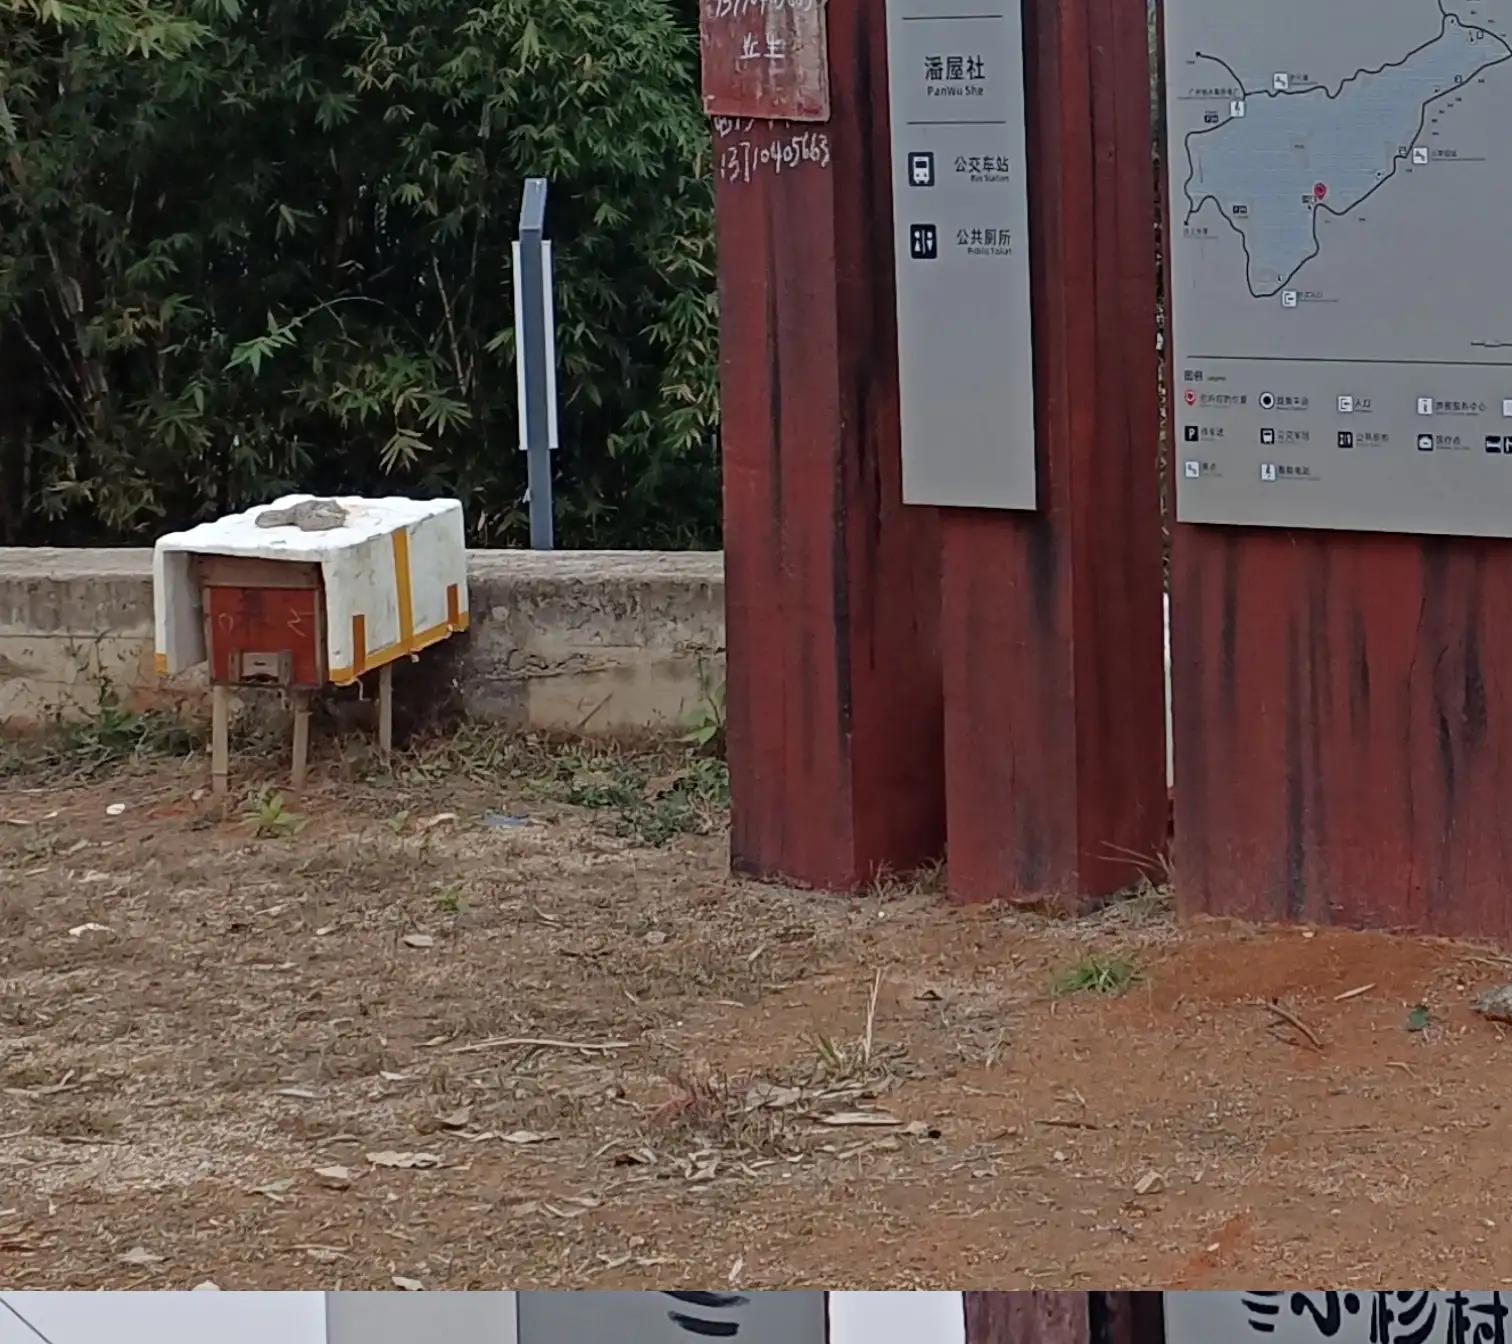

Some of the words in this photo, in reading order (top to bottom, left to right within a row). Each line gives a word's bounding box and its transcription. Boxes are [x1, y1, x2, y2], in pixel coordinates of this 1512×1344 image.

[965, 85, 984, 96] She
[954, 155, 1009, 173] 公交车站
[957, 228, 1011, 246] 公共厕所
